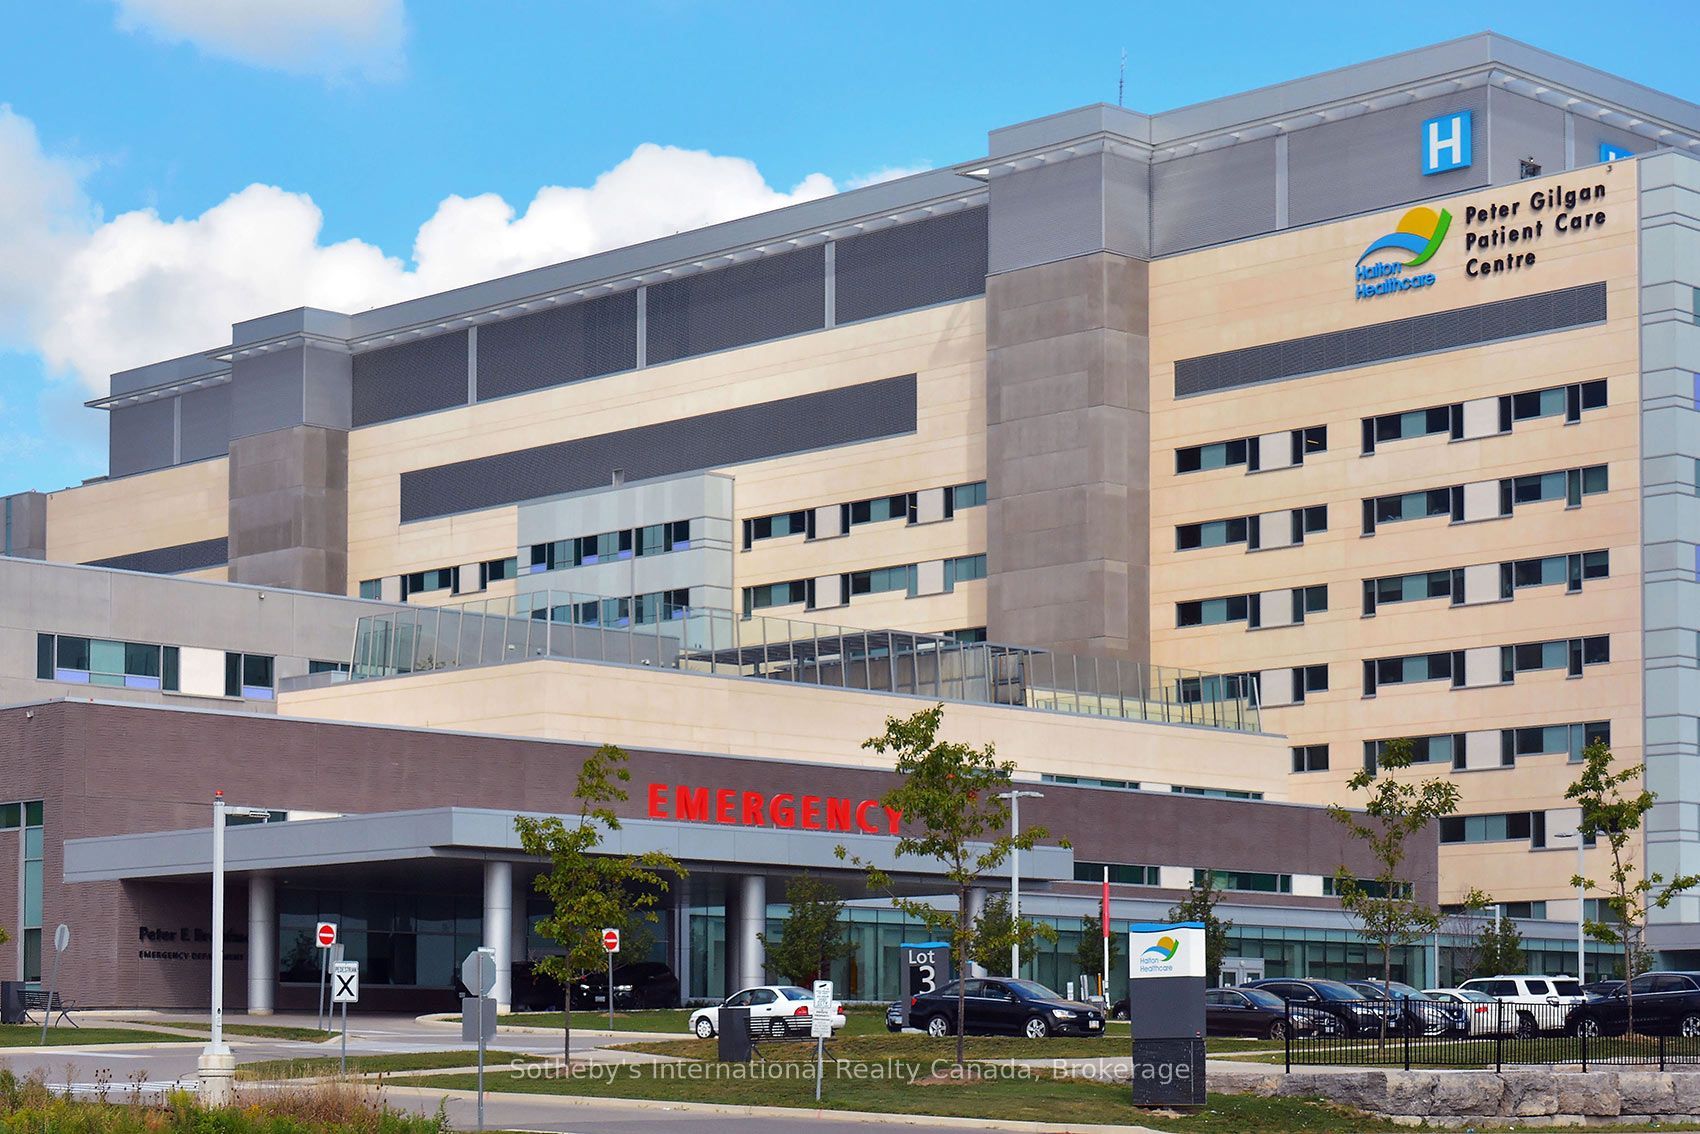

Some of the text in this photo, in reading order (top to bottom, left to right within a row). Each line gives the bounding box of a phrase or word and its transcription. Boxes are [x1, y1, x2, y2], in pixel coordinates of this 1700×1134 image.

[1429, 117, 1461, 169] H
[1466, 184, 1606, 225] Peter Gilgan
[1466, 212, 1606, 250] Patient Care
[1356, 262, 1402, 281] Halton
[1466, 253, 1536, 277] Centre
[1356, 273, 1436, 299] Healthcare
[648, 783, 904, 835] EMERGENCY
[139, 926, 177, 942] Peter
[139, 950, 189, 960] EMERGENCY
[908, 949, 935, 964] Lot
[919, 965, 936, 995] 3
[1140, 965, 1173, 973] Healthcare
